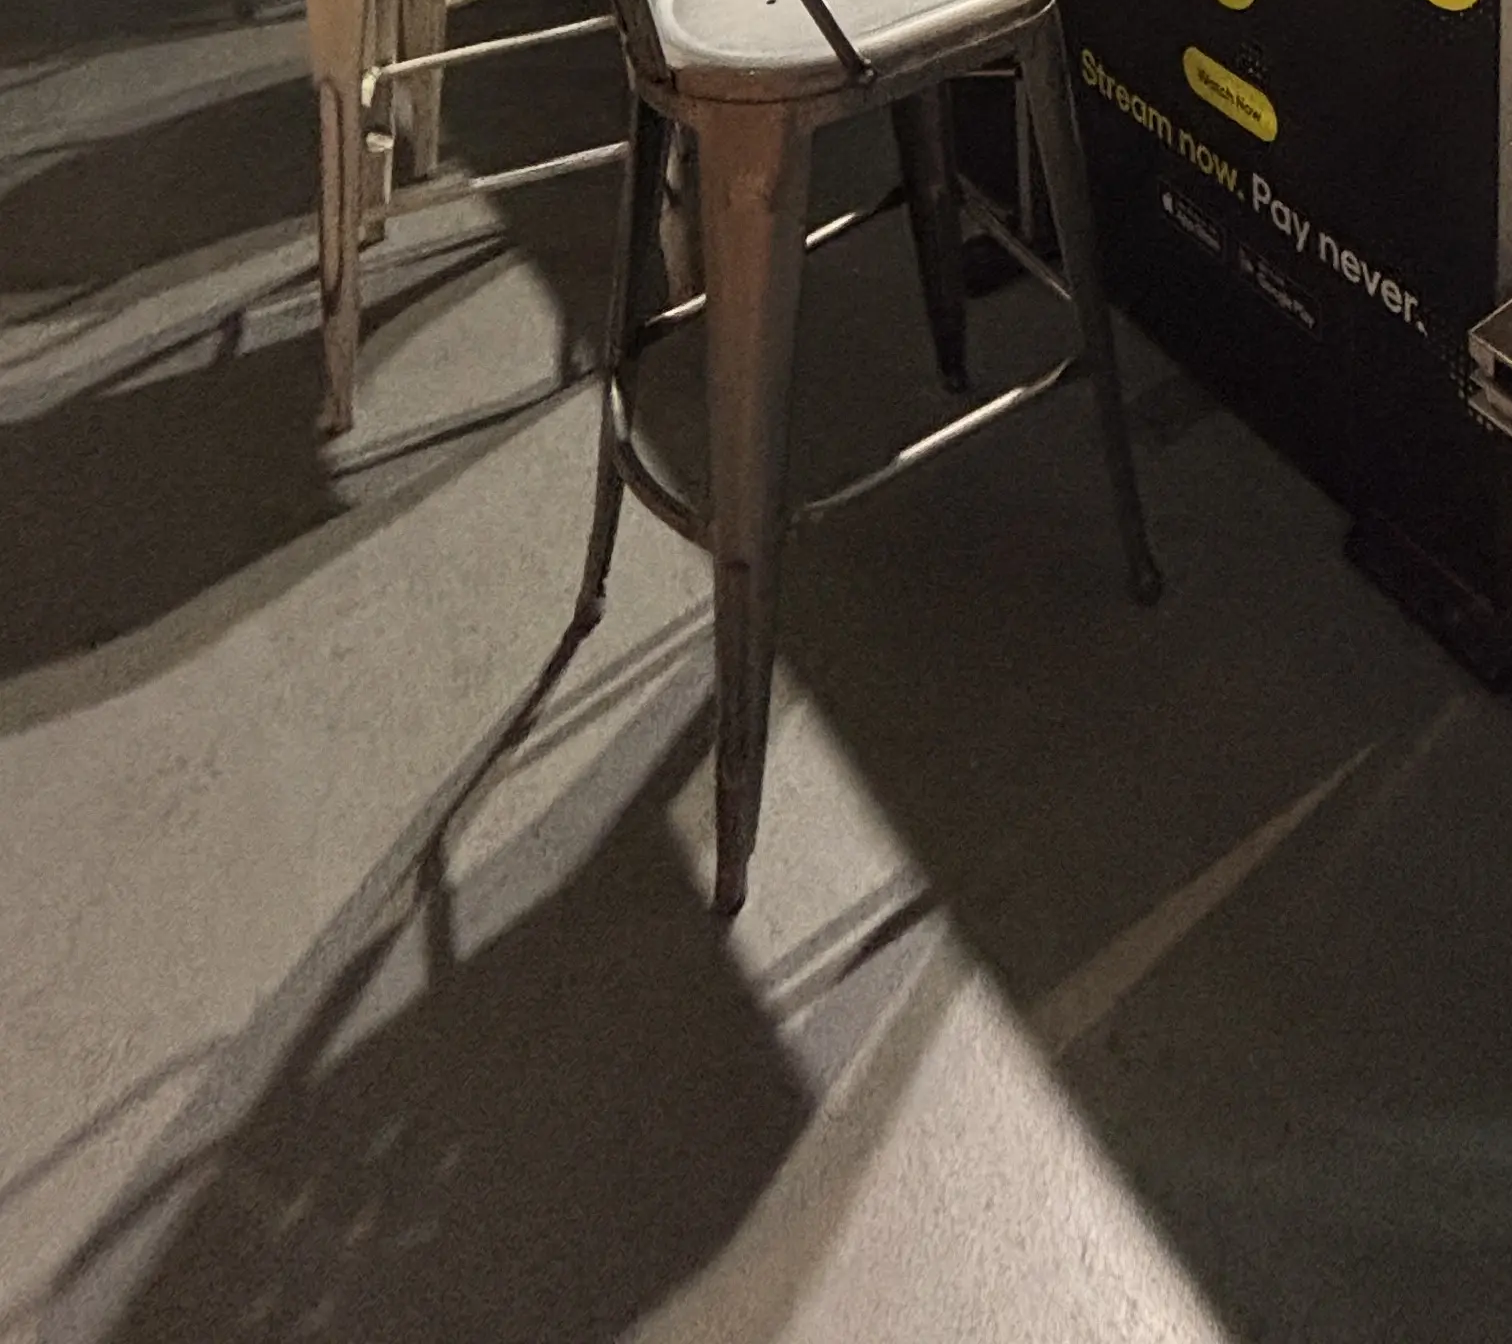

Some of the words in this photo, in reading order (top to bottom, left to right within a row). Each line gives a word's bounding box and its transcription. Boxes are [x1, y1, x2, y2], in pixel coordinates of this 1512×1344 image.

[1082, 48, 1173, 148] Stream
[1177, 130, 1245, 202] now.
[1252, 172, 1310, 253] Pay
[1318, 231, 1429, 339] never.
